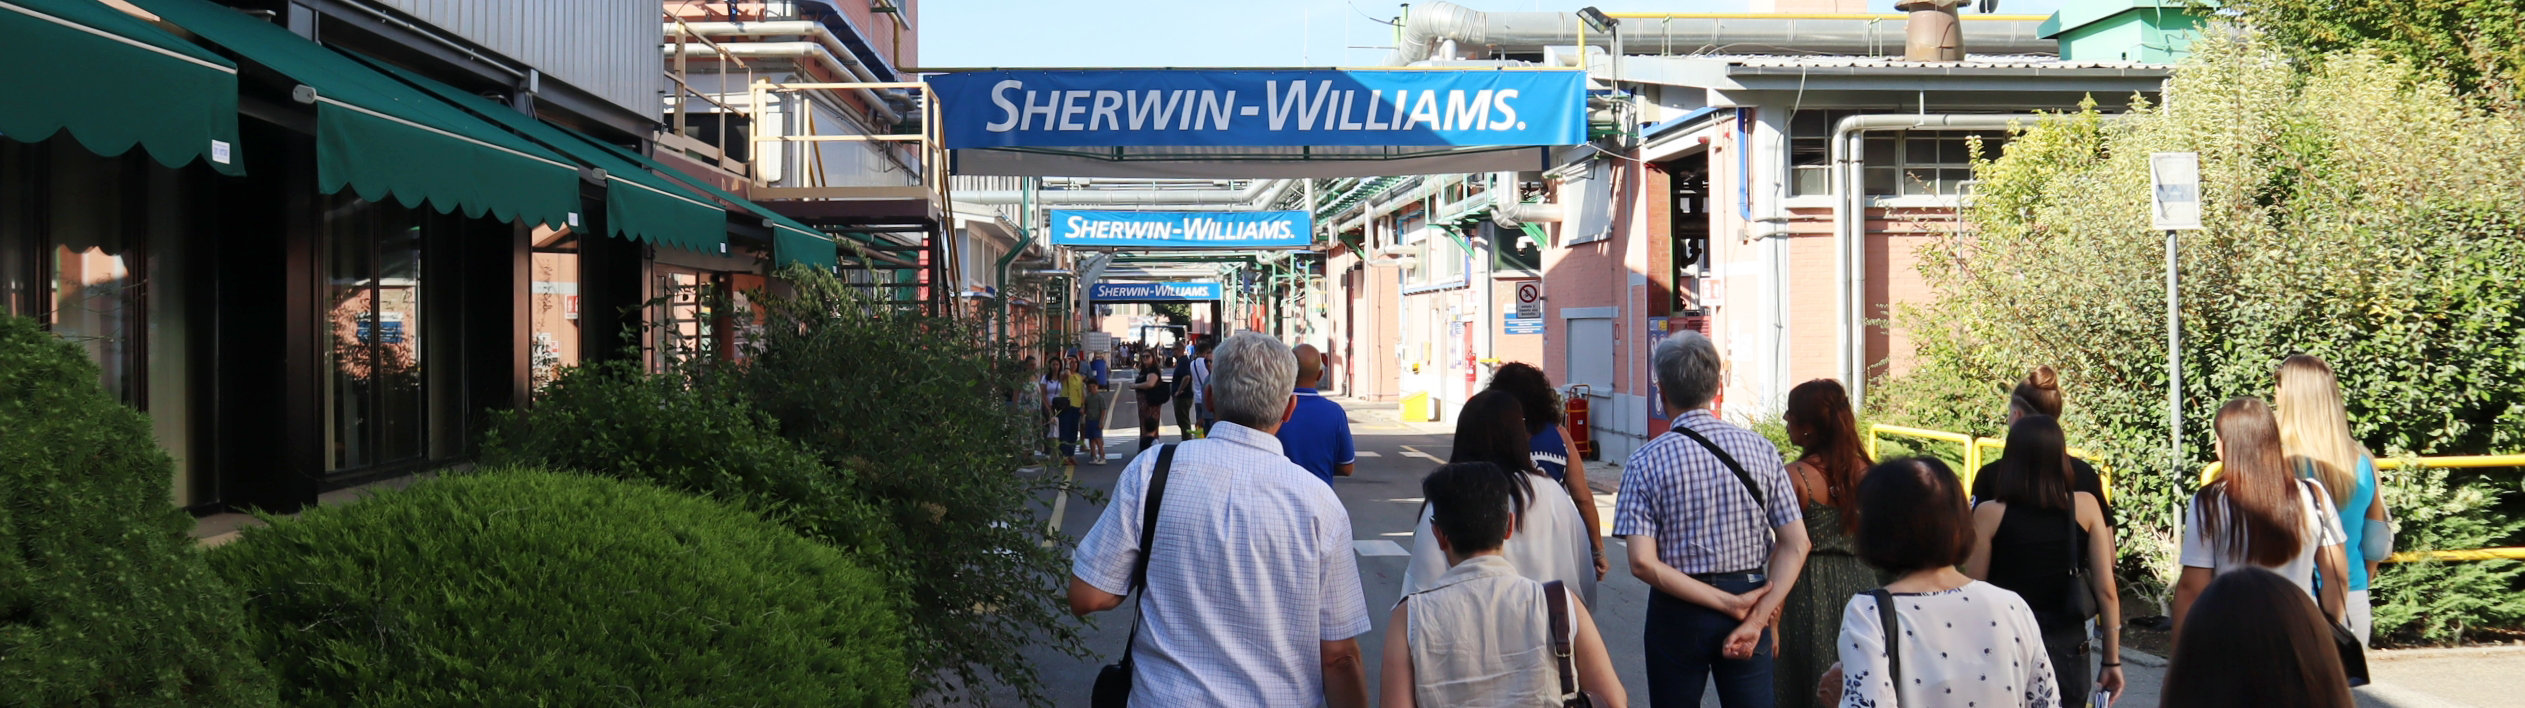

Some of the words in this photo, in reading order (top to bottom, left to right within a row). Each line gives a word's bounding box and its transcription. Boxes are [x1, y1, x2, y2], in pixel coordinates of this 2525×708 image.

[986, 80, 1526, 132] SHERWIN-WILLIAMS.
[1064, 215, 1296, 241] SHERWIN-WILLIAMS.
[1097, 285, 1210, 297] SHERWIN-WILLIAMS.
